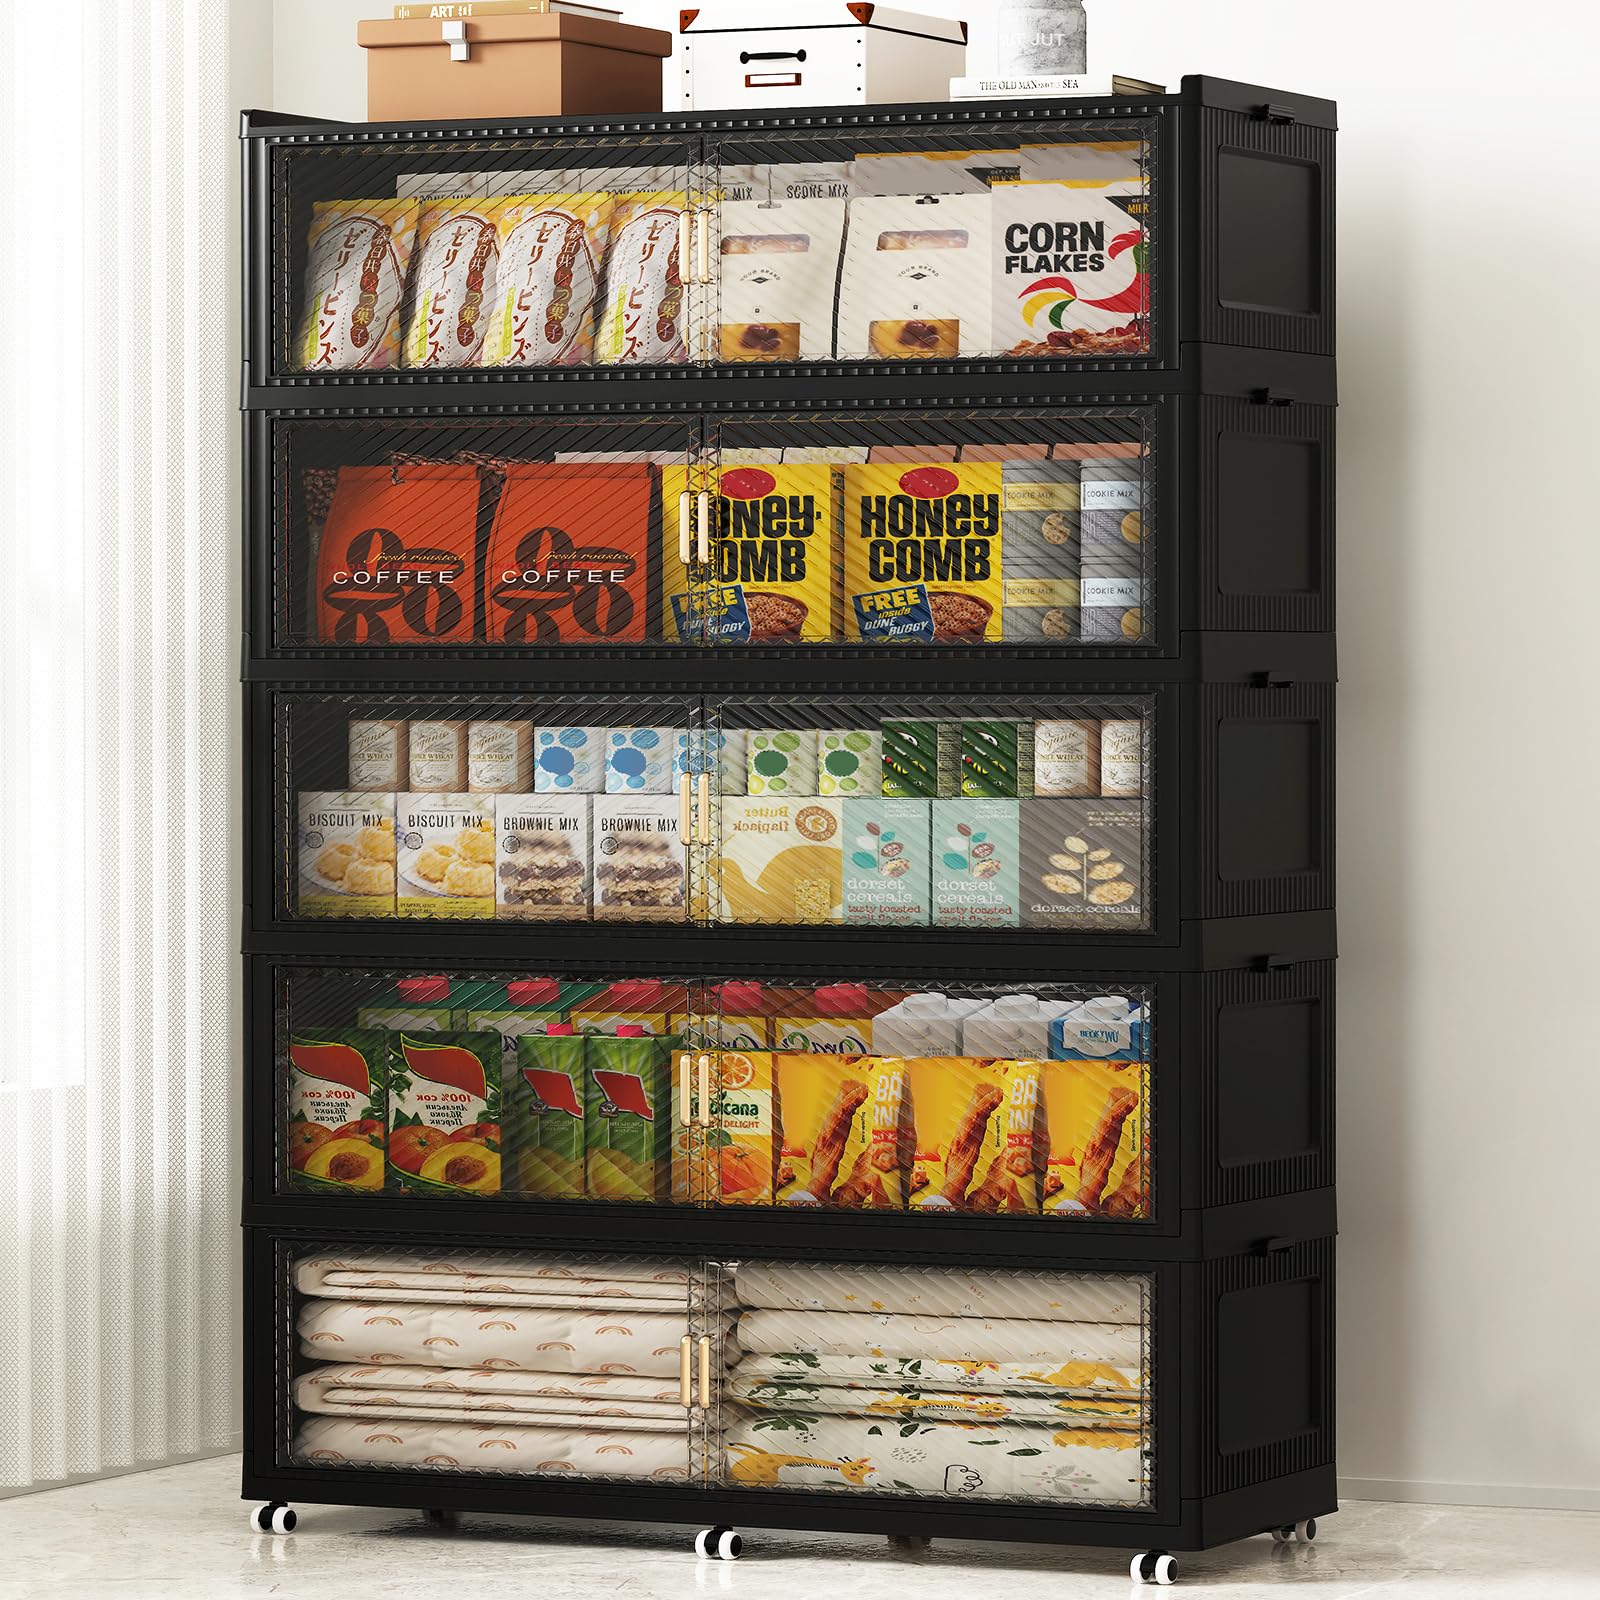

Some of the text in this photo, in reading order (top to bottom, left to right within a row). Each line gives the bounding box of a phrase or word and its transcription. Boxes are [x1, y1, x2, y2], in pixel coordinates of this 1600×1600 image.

[429, 5, 456, 18] ART
[979, 81, 998, 91] THE
[998, 80, 1017, 90] OLD
[1018, 79, 1037, 90] MAN
[1062, 79, 1079, 89] SEA
[786, 183, 849, 200] SCONE MIX
[1004, 220, 1105, 254] CORN
[1004, 253, 1105, 274] FLAKES
[317, 227, 368, 365] ゼリービンズ
[423, 225, 476, 367] ゼリービンズ
[508, 221, 561, 363] ゼリービンズ
[619, 219, 672, 363] ゼリービンズ
[1037, 491, 1054, 500] MIX
[1086, 490, 1135, 498] COOKIE MIX
[688, 539, 807, 583] OMB
[868, 538, 992, 583] COMB
[332, 570, 455, 585] COFFEE
[501, 569, 626, 584] COFFEE
[1037, 587, 1054, 595] MIX
[1086, 587, 1135, 595] COOKIE MIX
[860, 587, 921, 613] FREE
[878, 607, 911, 620] inside
[864, 616, 897, 631] DUNE
[888, 620, 930, 636] BUGGY
[308, 813, 384, 827] BISCUIT MIX
[407, 814, 484, 828] BISCUIT MIX
[503, 817, 579, 831] BROWNIE MIX
[601, 818, 678, 832] BROWNIE MIX
[847, 878, 905, 890] dorset
[937, 879, 997, 892] dorset
[847, 891, 913, 903] cereals
[937, 892, 1004, 904] cereals
[848, 905, 921, 914] tasty toasted
[939, 906, 1013, 915] tasty toasted
[723, 1120, 760, 1129] DELIGHT
